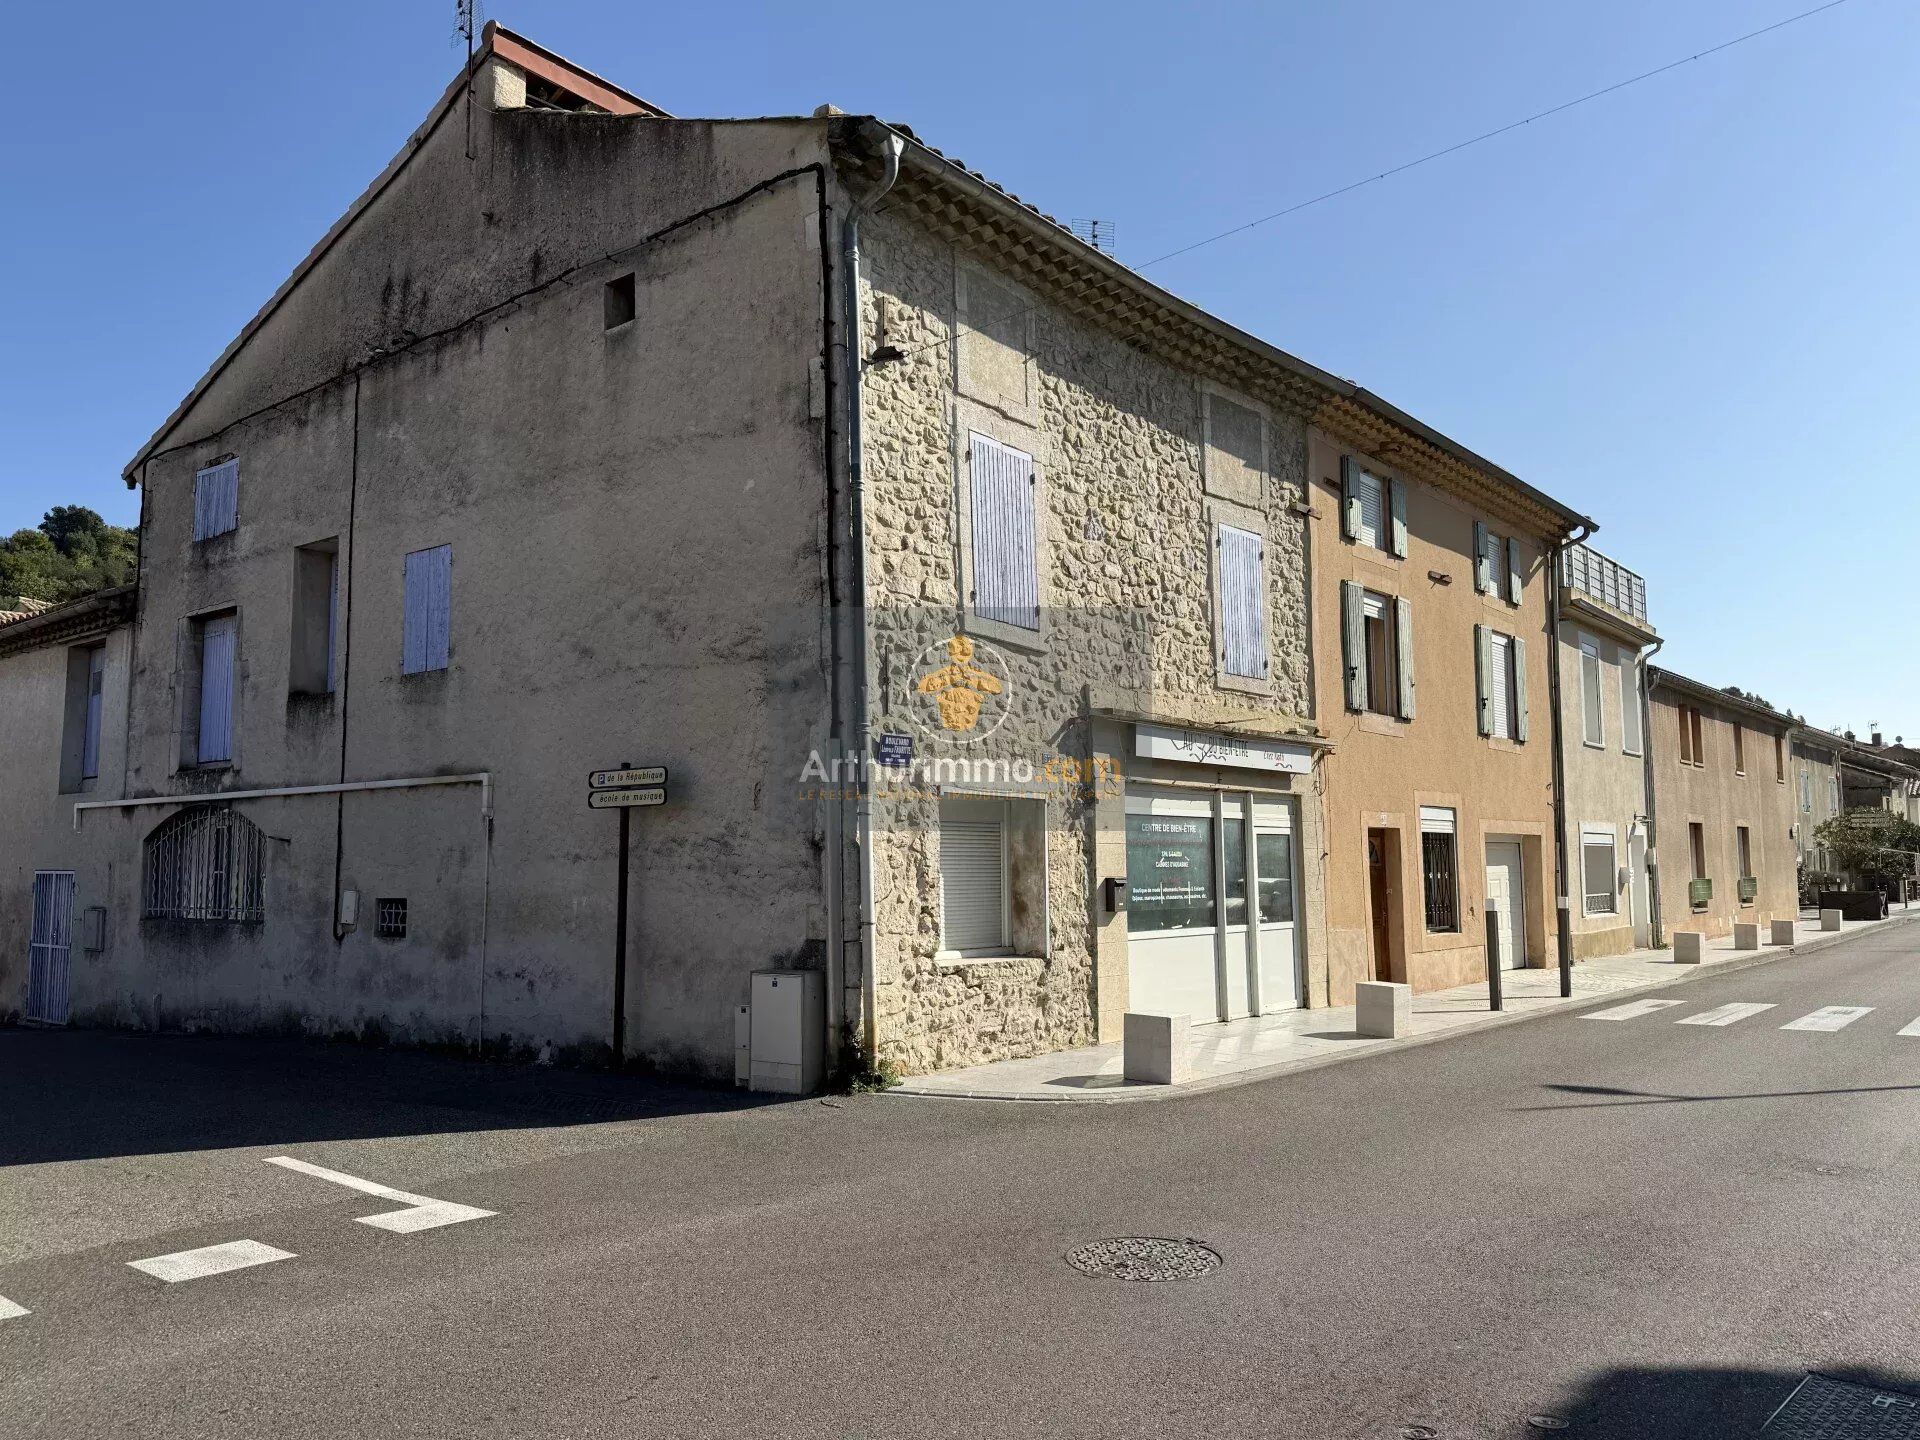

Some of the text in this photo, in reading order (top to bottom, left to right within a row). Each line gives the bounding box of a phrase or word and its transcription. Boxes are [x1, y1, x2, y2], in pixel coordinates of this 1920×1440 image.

[607, 773, 615, 782] de
[617, 773, 624, 782] la
[625, 771, 663, 783] République
[600, 791, 663, 803] école de musique
[1141, 822, 1197, 833] CENTRE DE BIEN-ÊTRE
